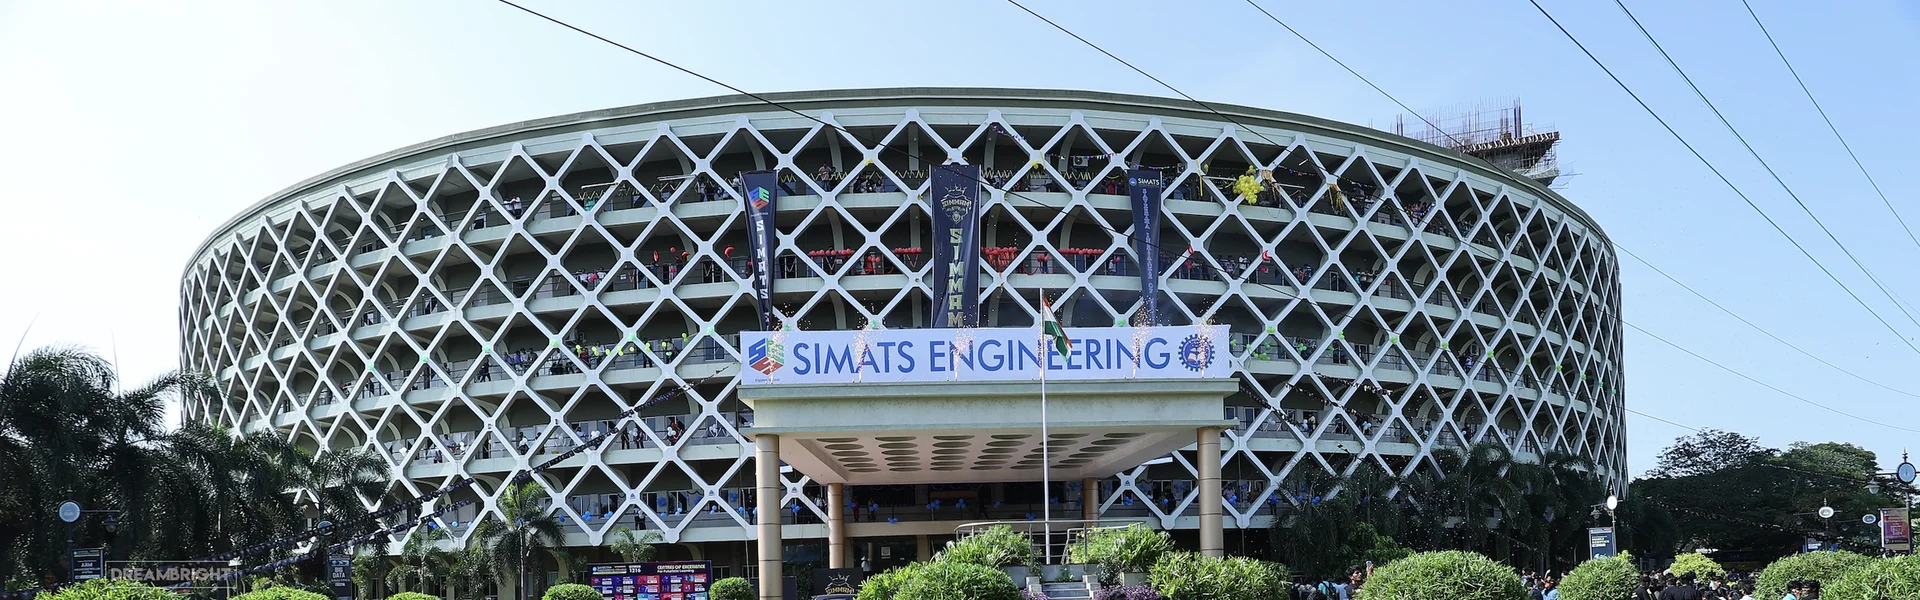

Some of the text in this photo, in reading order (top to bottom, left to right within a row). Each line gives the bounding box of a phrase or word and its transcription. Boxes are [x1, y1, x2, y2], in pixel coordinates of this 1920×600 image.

[1137, 177, 1160, 186] SIMATS
[756, 219, 769, 300] SIMATS
[947, 228, 965, 328] SIMMAM
[793, 341, 915, 375] SIMATS
[929, 337, 1170, 372] ENGINEERING
